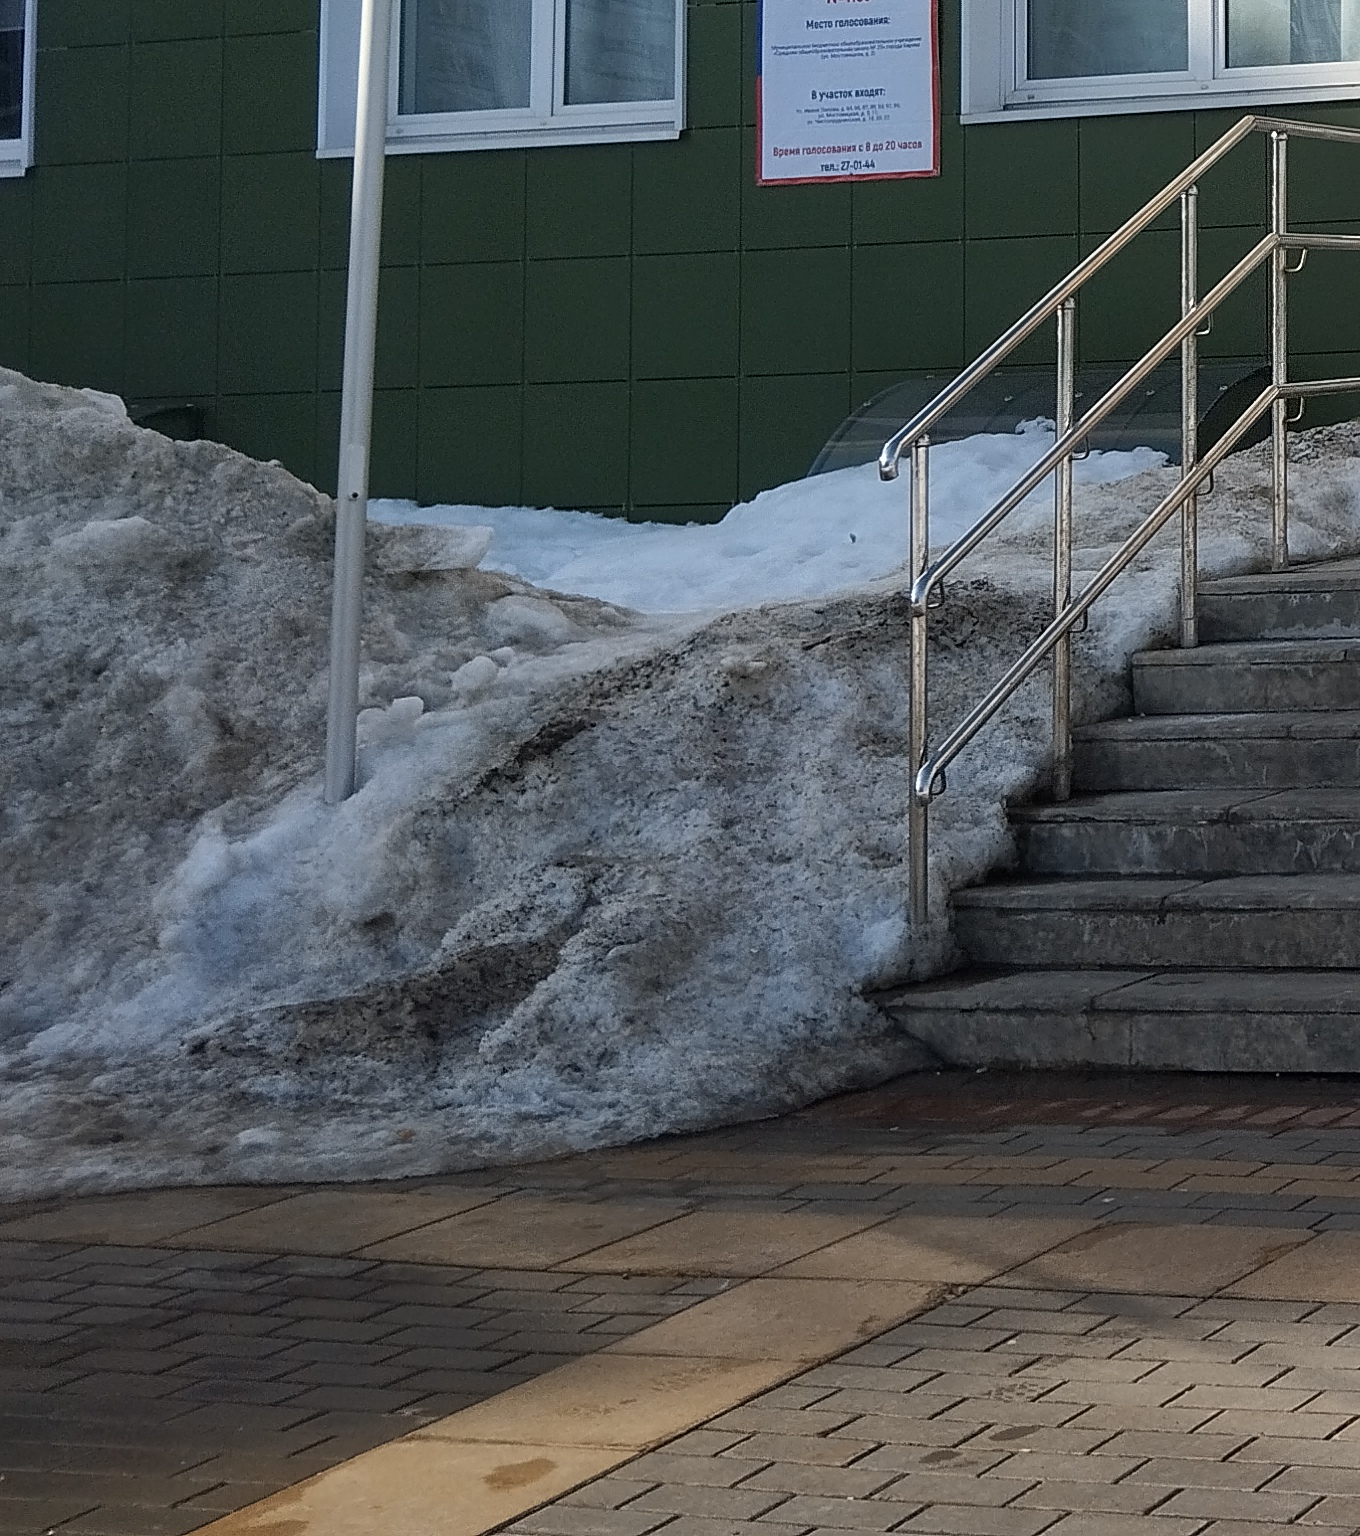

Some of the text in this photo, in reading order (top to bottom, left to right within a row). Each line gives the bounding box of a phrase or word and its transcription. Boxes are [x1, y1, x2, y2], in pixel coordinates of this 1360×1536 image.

[806, 16, 891, 30] Место голосования:
[811, 87, 886, 102] В участок входят:
[773, 139, 923, 158] Время голосования с 8 до 20 часов
[840, 159, 876, 171] 27-01-44
